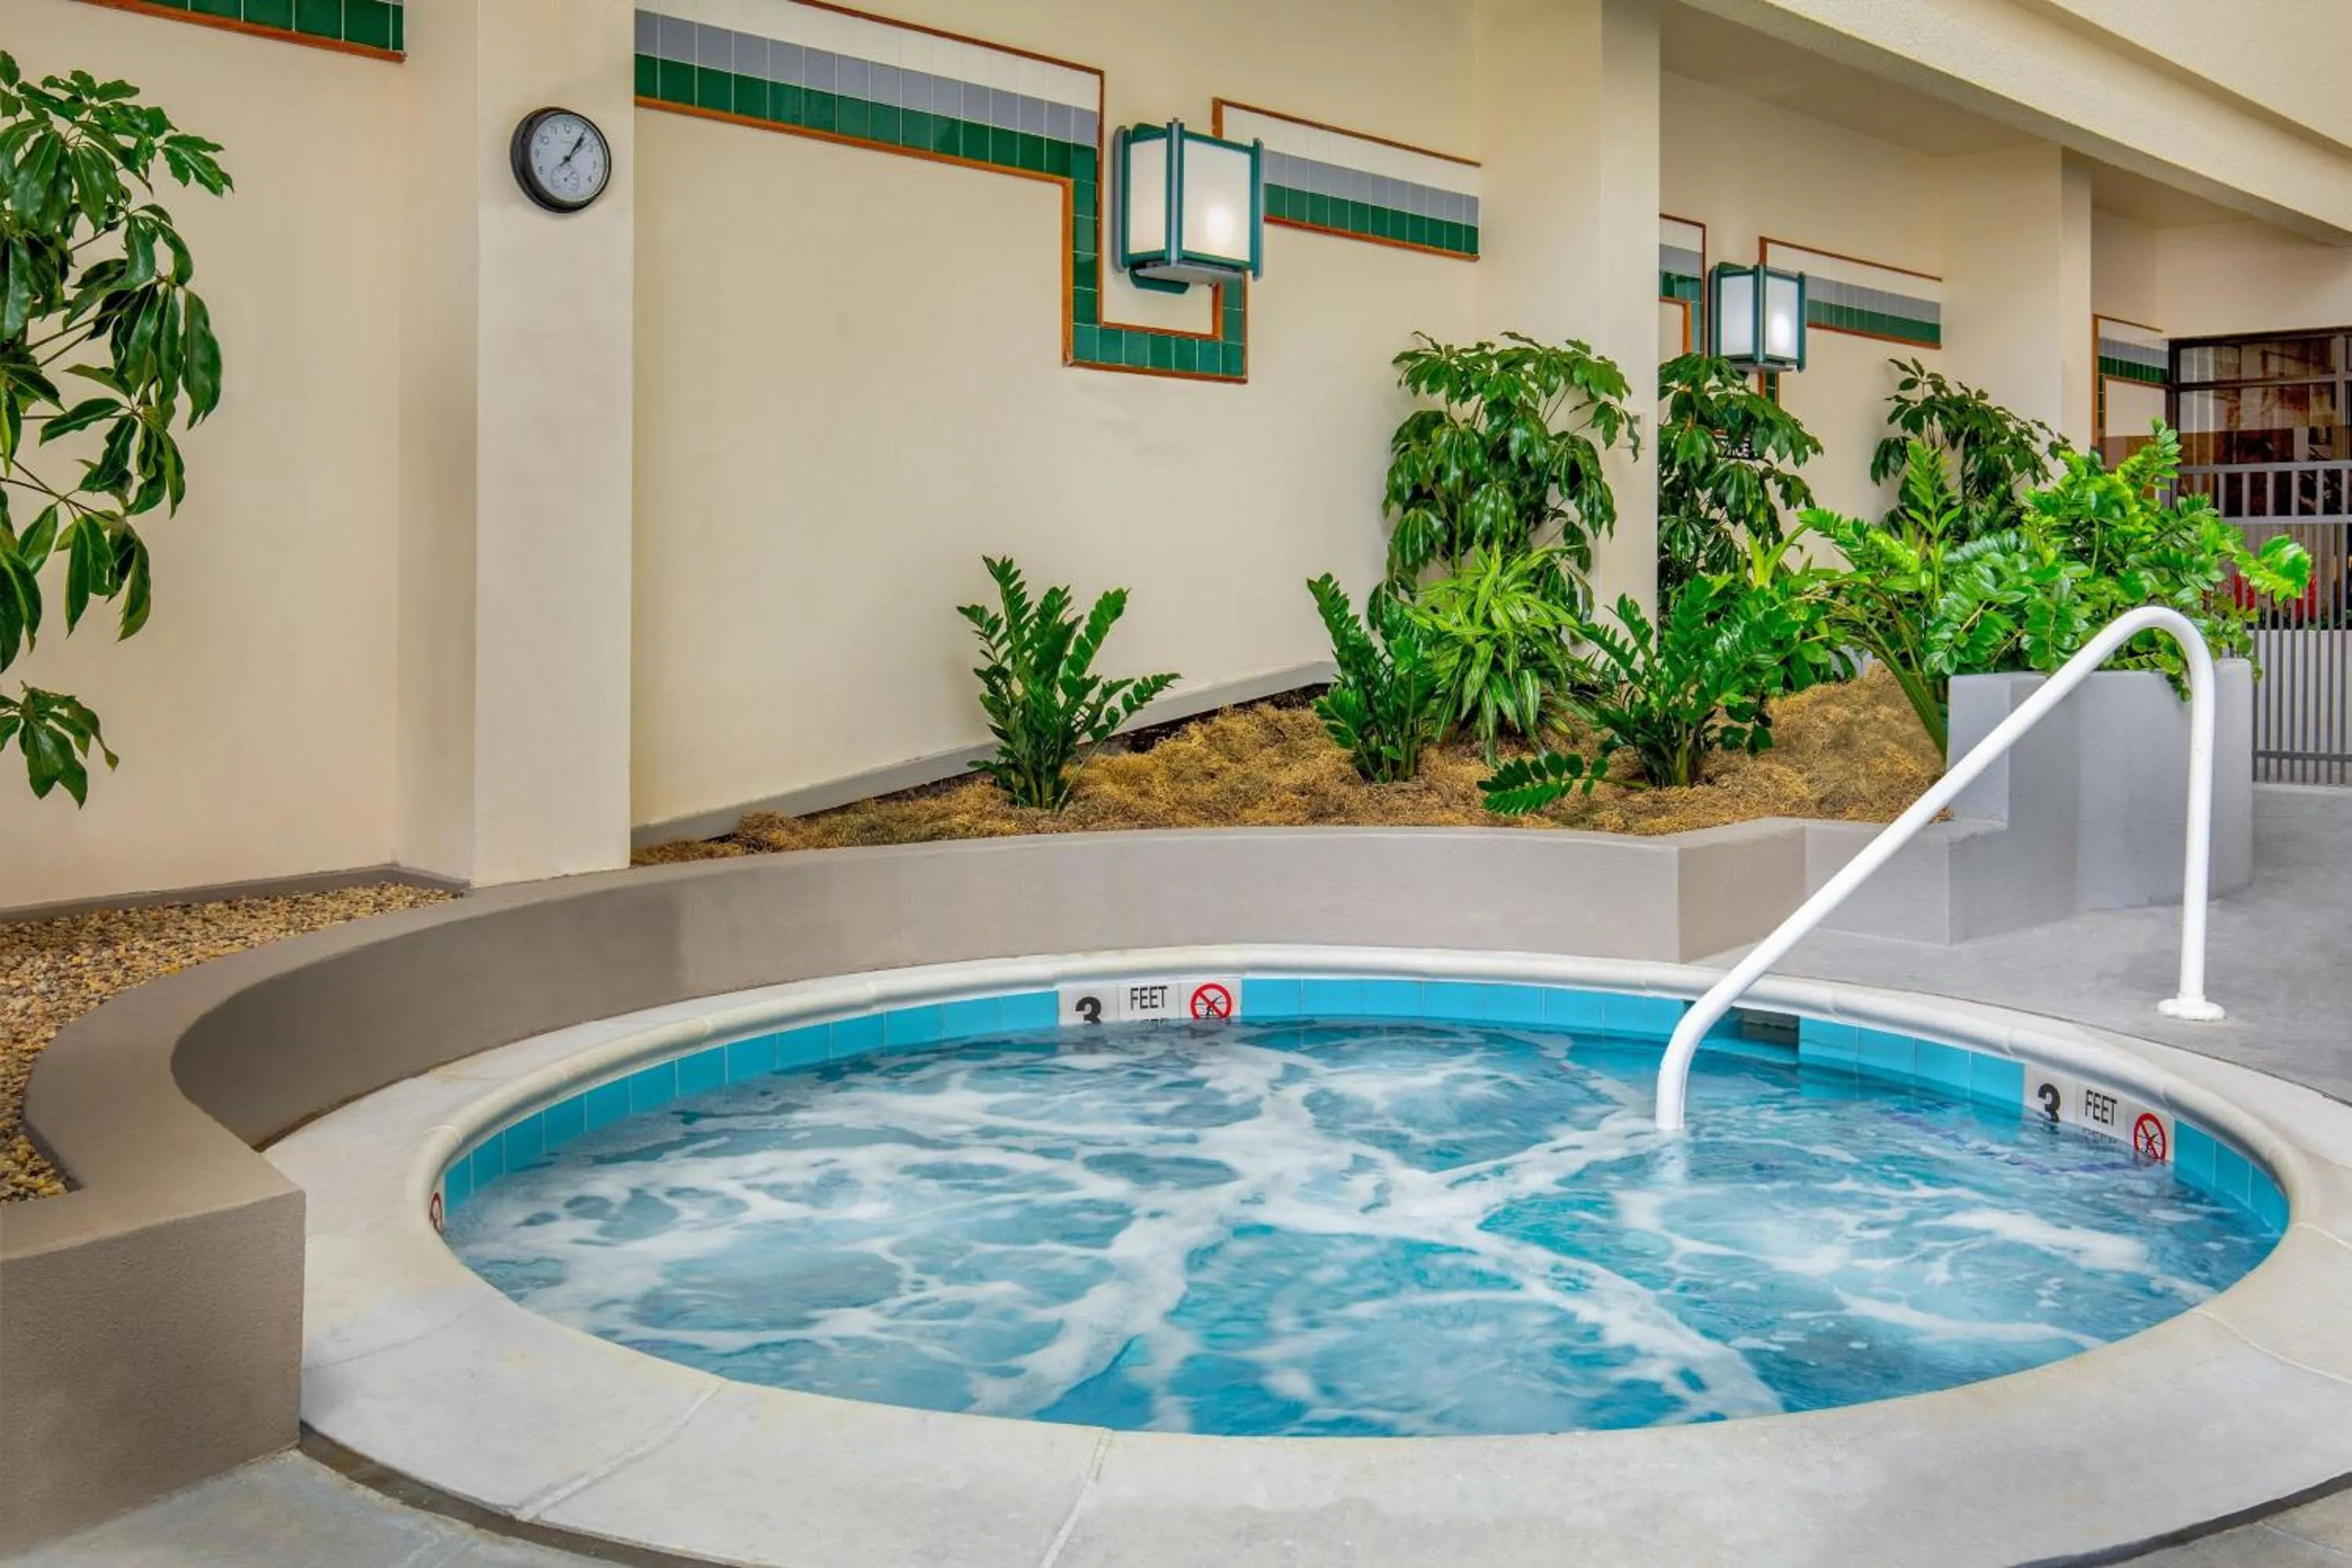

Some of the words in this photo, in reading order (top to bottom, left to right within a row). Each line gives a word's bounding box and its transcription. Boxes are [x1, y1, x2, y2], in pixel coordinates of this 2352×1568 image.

[1076, 996, 1102, 1026] 3
[1130, 985, 1167, 1010] FEET
[2038, 1083, 2061, 1123] 3
[2085, 1089, 2117, 1126] FEET
